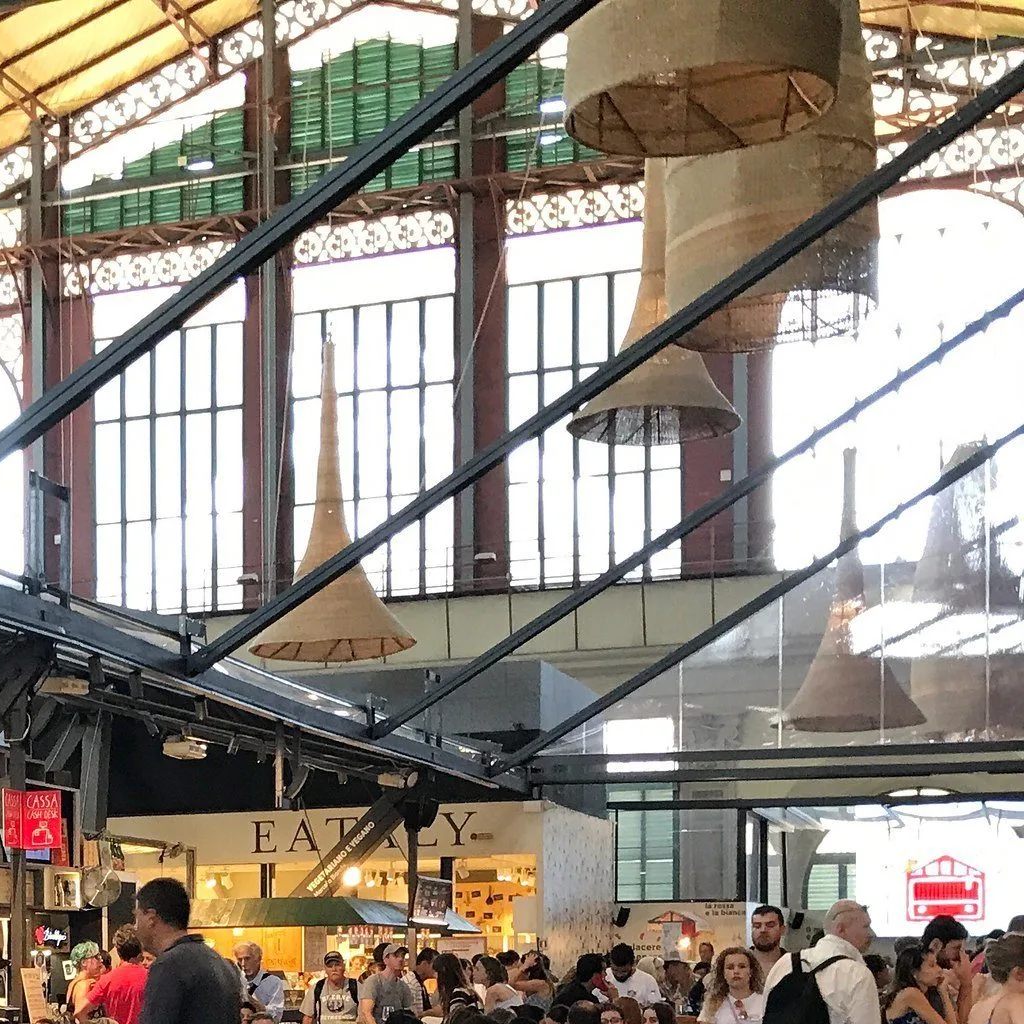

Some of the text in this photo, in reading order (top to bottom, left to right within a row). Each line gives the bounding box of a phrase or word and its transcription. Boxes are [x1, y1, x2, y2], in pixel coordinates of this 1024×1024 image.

[26, 794, 58, 809] CASSA
[251, 811, 477, 854] EATY
[306, 850, 348, 892] VEGETARIANO
[344, 844, 353, 853] E
[349, 821, 375, 848] VEGANO
